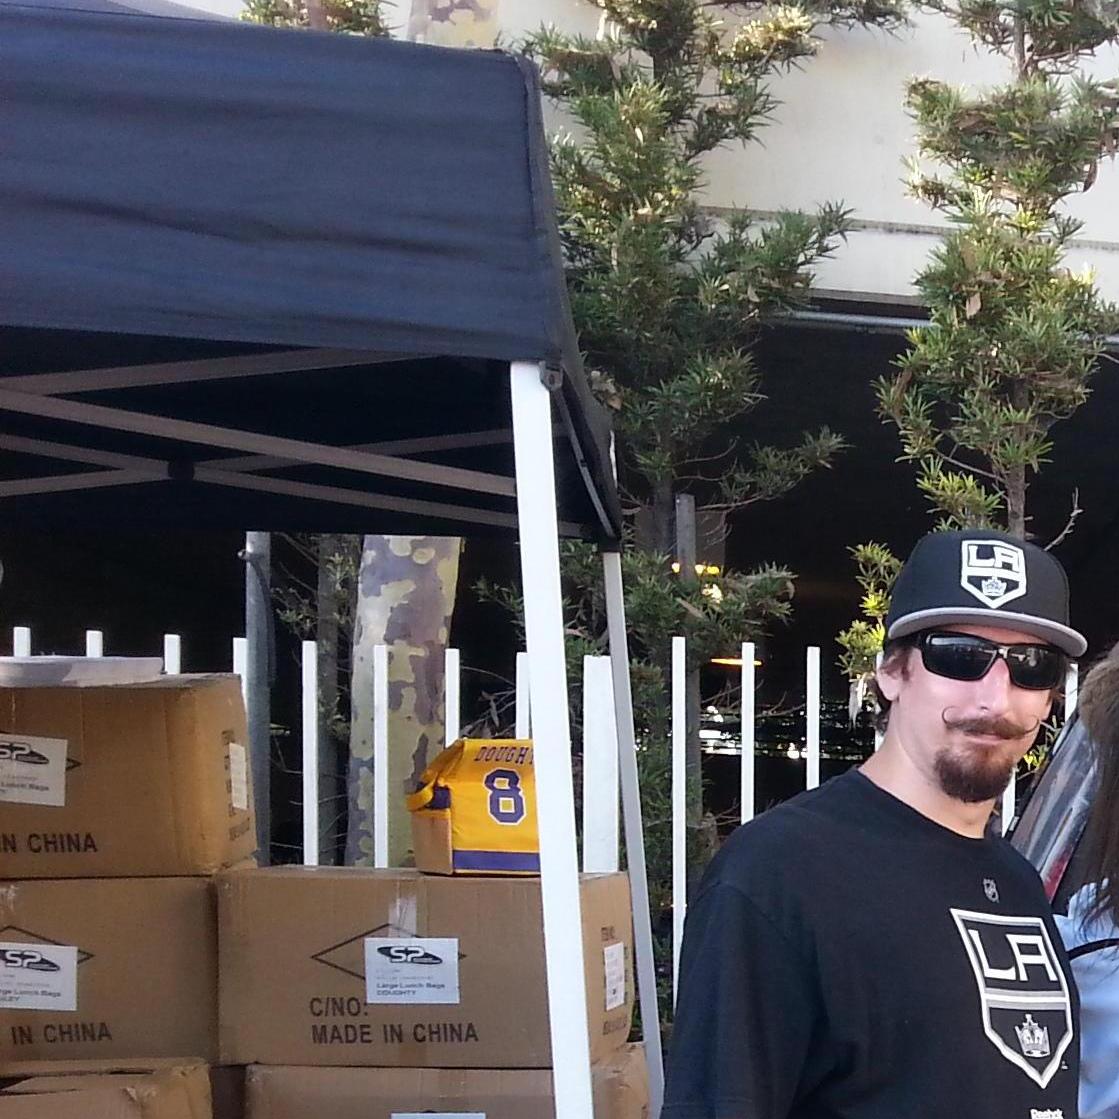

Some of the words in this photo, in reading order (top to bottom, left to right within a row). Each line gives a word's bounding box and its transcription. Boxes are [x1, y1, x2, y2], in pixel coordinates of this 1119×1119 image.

[968, 545, 1020, 573] LA
[474, 746, 534, 765] DOUGH
[484, 768, 527, 825] 8
[28, 833, 98, 853] CHINA
[968, 929, 1059, 982] LA
[309, 997, 369, 1017] C/NO:
[11, 1025, 33, 1045] IN
[43, 1022, 113, 1043] CHINA
[312, 1024, 373, 1044] MADE
[383, 1024, 403, 1043] IN
[413, 1022, 479, 1043] CHINA
